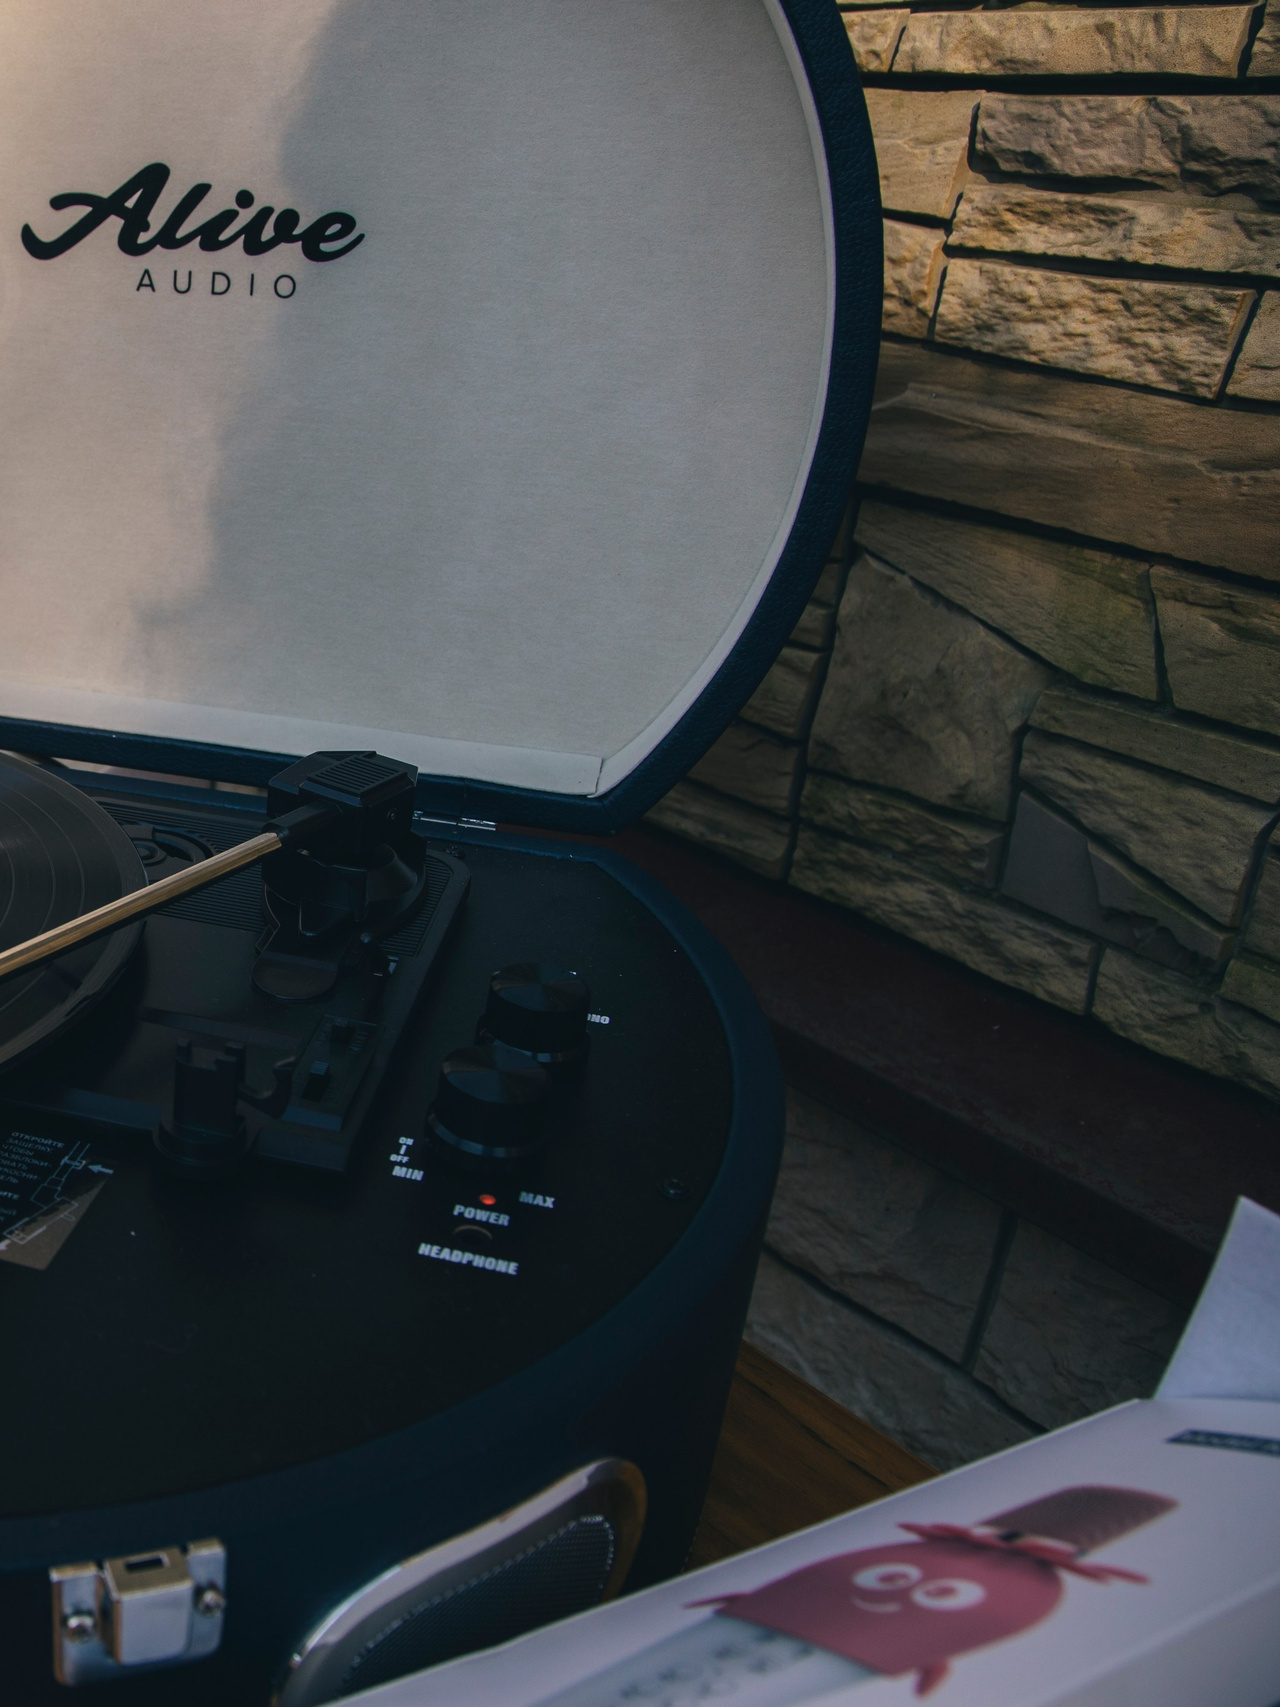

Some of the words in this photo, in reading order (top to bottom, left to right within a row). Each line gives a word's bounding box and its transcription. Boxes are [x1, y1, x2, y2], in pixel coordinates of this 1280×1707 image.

[20, 162, 365, 262] Alive
[136, 268, 297, 299] AUDIO
[12, 1132, 65, 1149] ОТКРОЙТЕ
[399, 1136, 414, 1146] ON
[389, 1154, 410, 1164] OFF
[392, 1165, 424, 1181] MIN
[518, 1191, 556, 1209] MAX
[452, 1203, 511, 1227] POWER
[417, 1242, 520, 1276] HEADPHONE
